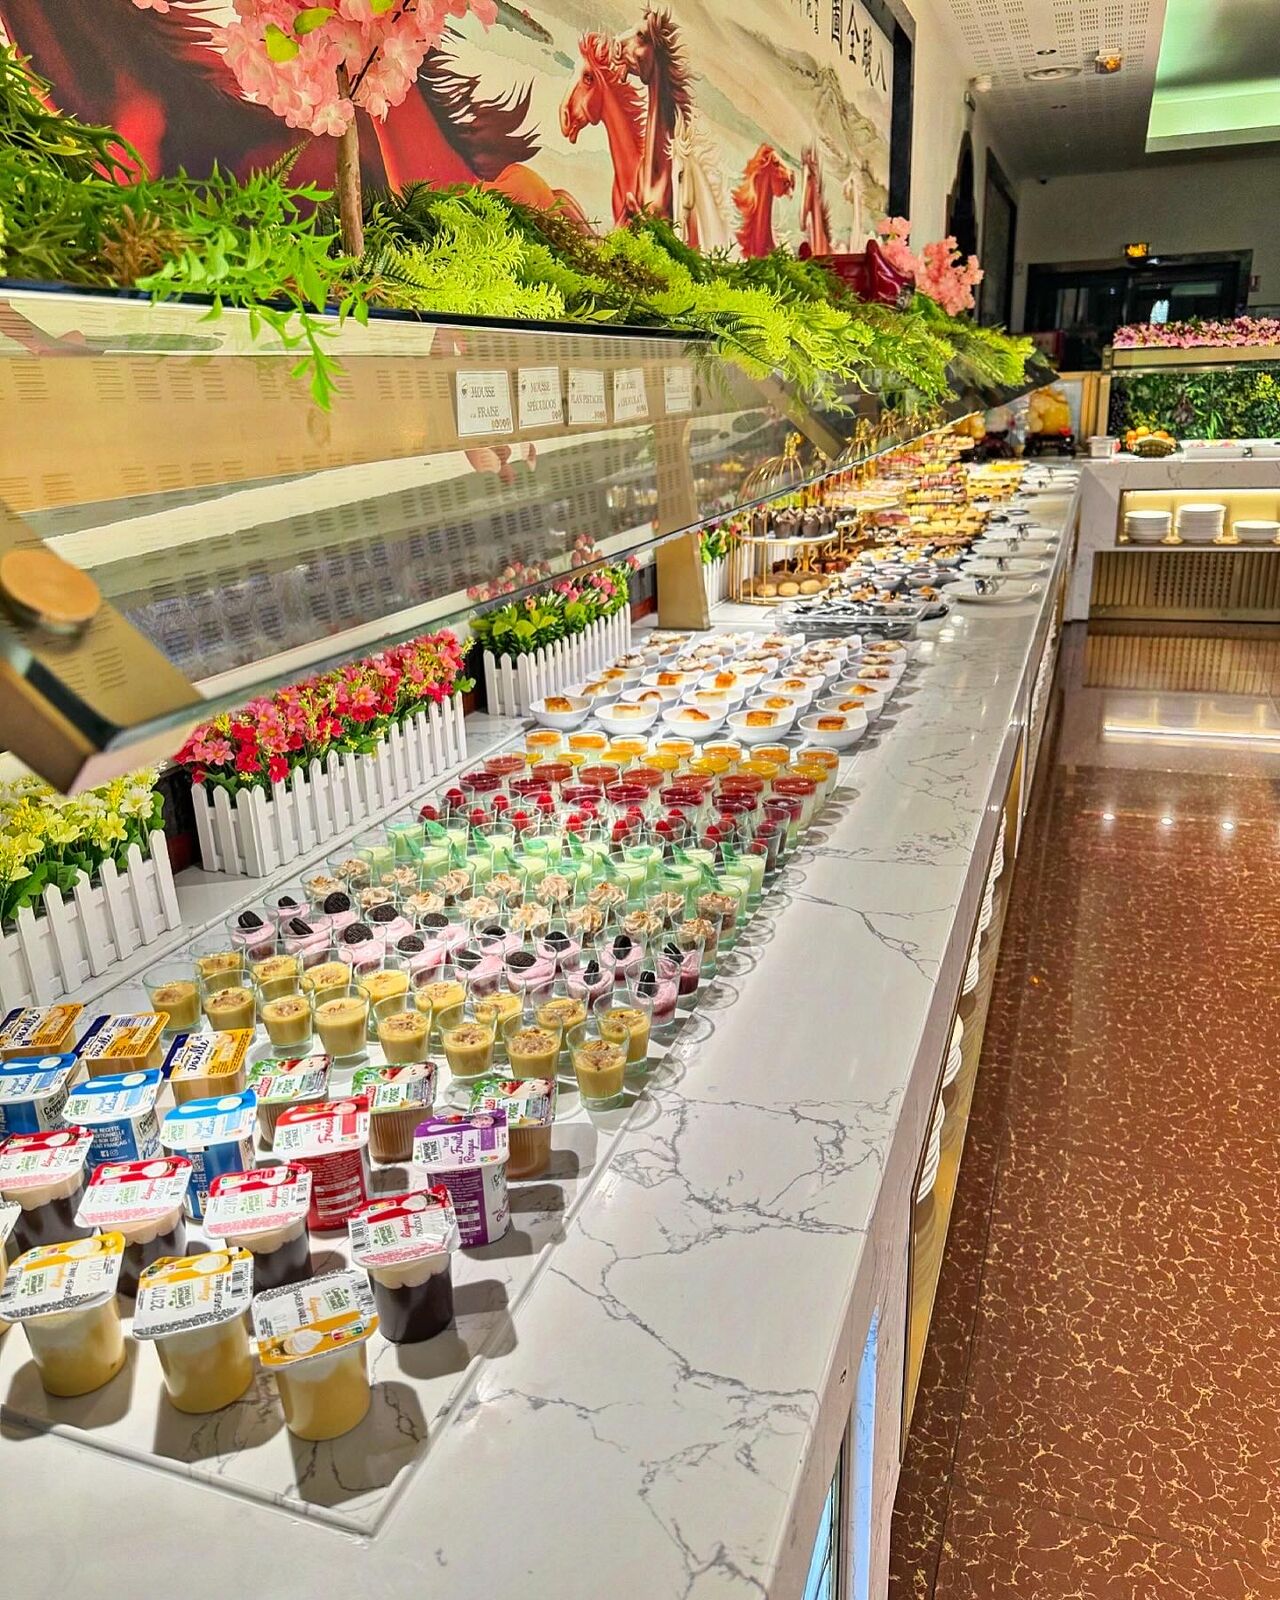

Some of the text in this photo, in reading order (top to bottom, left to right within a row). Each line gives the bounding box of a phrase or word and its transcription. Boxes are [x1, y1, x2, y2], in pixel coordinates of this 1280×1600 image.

[470, 386, 496, 399] MOUSSE
[478, 406, 500, 418] FRAISE
[450, 1131, 464, 1153] Fruits
[463, 1138, 479, 1163] Rouges
[215, 1272, 224, 1291] VANILLE
[149, 1285, 166, 1311] 23/01
[175, 1286, 186, 1309] CAMPAGNE
[183, 1285, 191, 1300] FRANCE
[331, 1288, 346, 1308] CAMPAGNE
[293, 1291, 308, 1326] SAVEUR VANILLE
[328, 1296, 338, 1310] FRANCE
